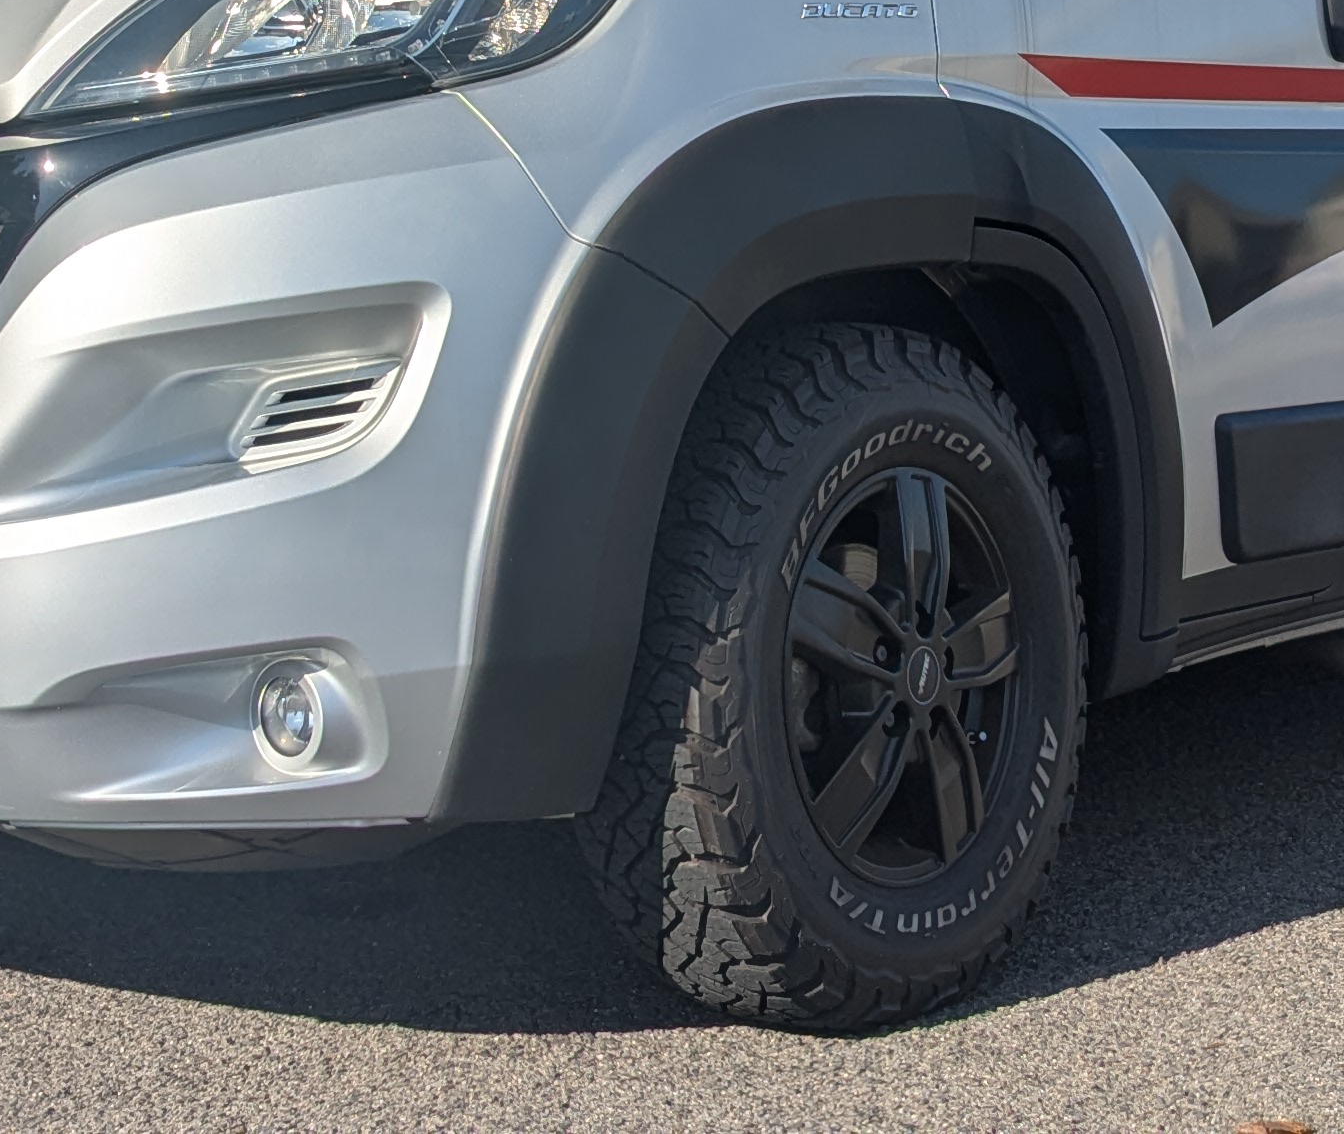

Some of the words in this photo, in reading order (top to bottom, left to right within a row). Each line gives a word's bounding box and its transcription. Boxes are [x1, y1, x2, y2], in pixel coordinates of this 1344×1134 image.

[800, 2, 919, 19] DUCATO
[781, 419, 993, 592] BFGoodrich
[896, 717, 1058, 939] All-Terrain
[830, 876, 886, 935] T/A
